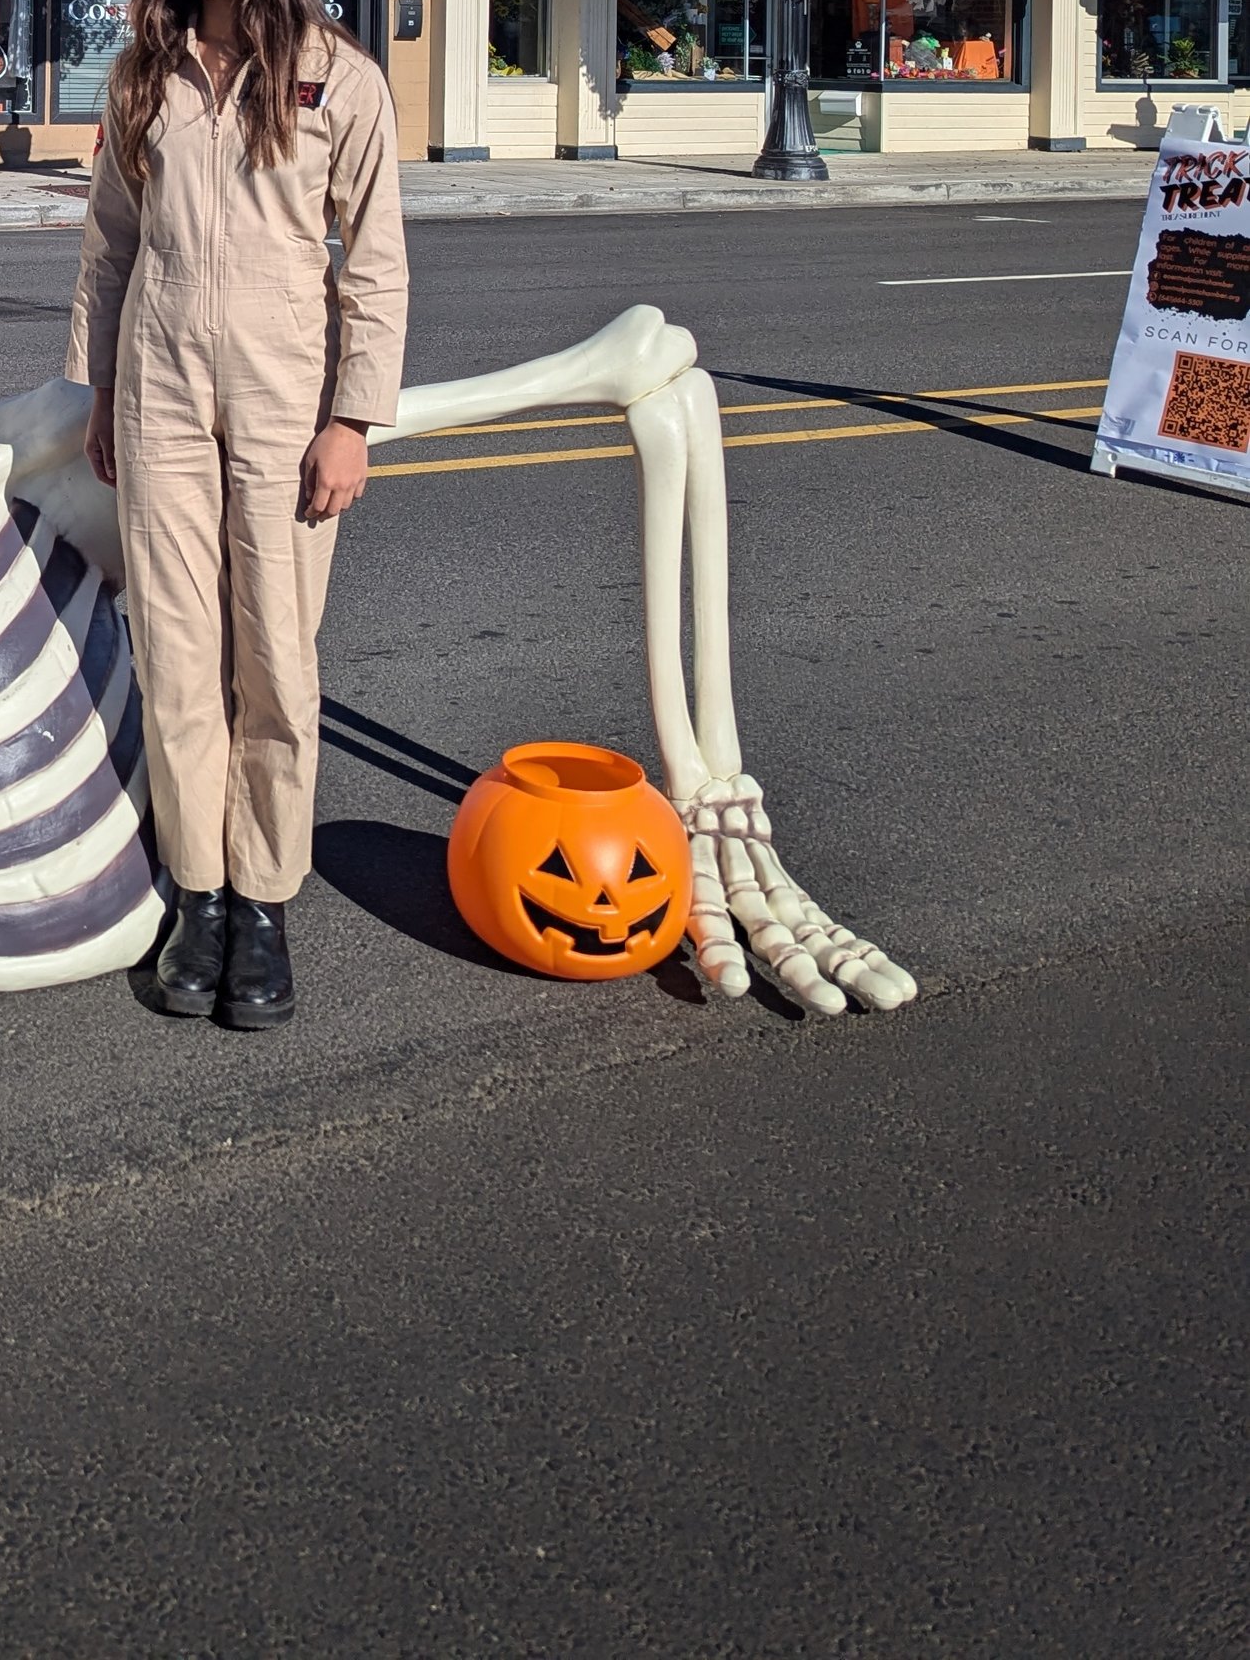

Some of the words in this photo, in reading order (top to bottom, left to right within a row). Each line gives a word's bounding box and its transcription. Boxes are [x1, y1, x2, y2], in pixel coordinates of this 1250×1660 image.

[1162, 151, 1249, 184] TRICK
[1184, 237, 1217, 247] children
[1225, 241, 1234, 249] of
[1156, 261, 1203, 274] information
[1193, 256, 1207, 265] For
[1226, 262, 1250, 271] more
[1145, 326, 1197, 345] SCAN
[1207, 336, 1248, 354] FOR
